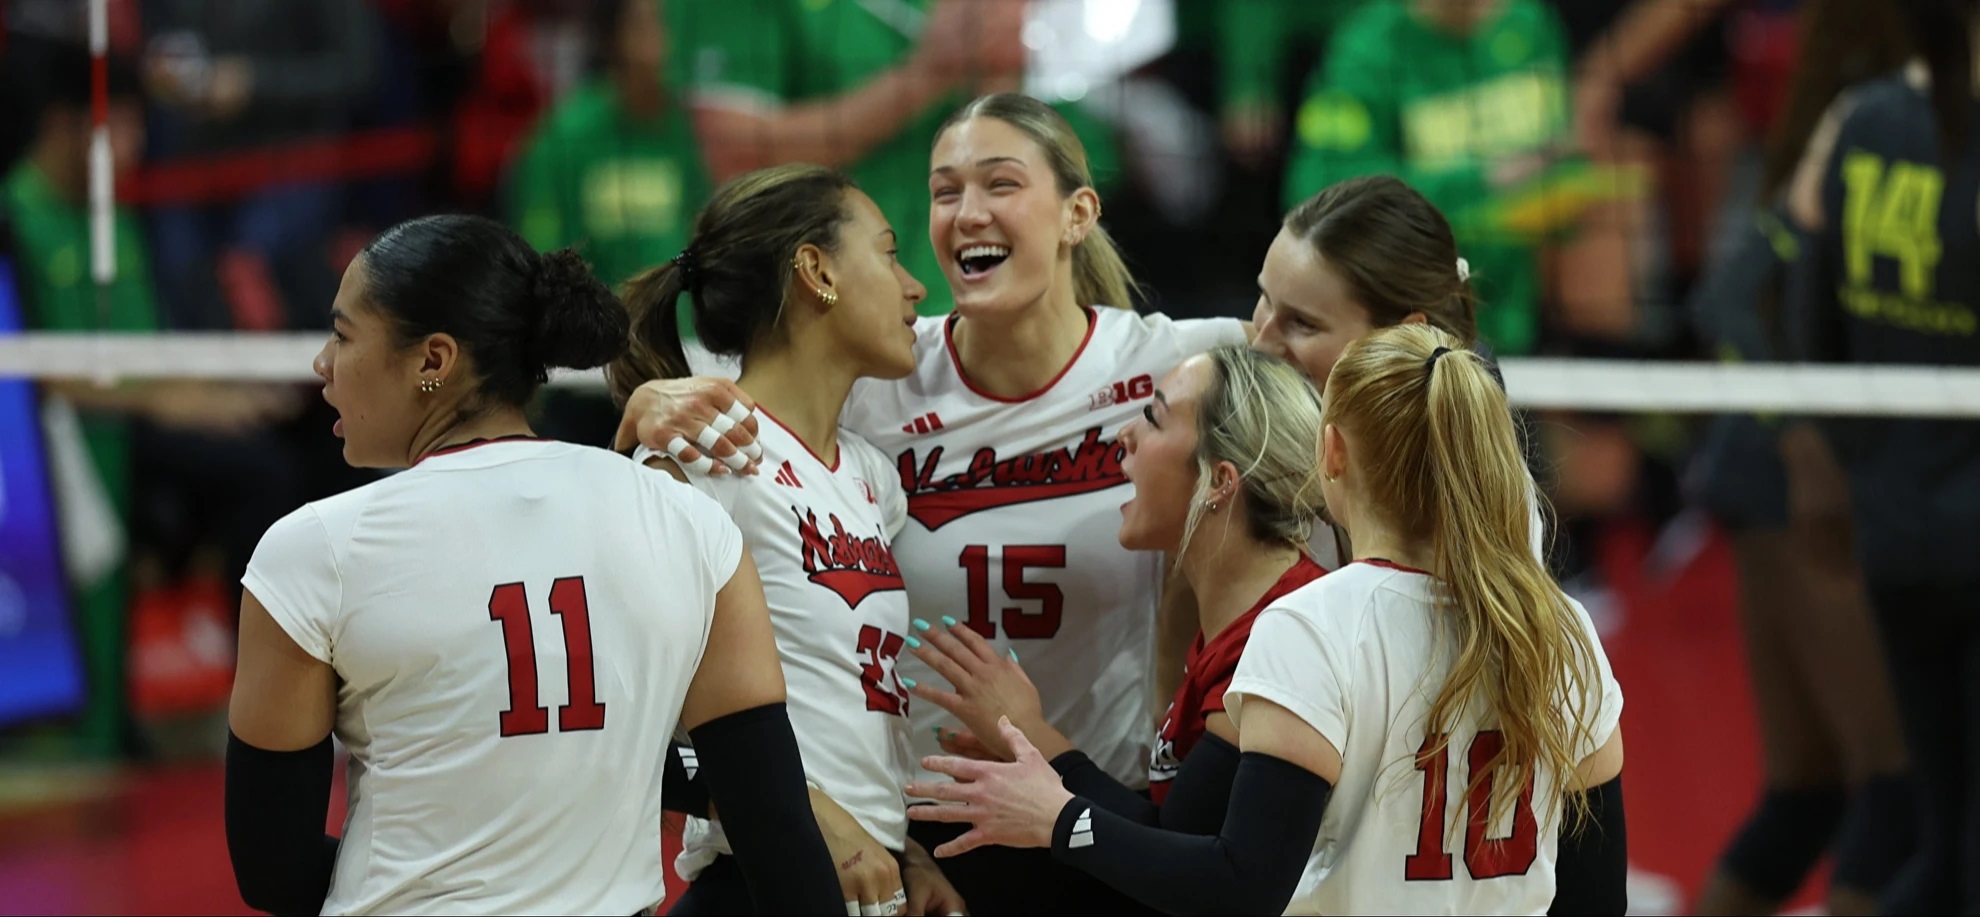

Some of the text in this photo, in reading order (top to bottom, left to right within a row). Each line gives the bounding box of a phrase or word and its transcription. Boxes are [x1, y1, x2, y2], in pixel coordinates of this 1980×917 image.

[1842, 151, 1943, 300] 14
[488, 575, 606, 737] 11
[959, 545, 1066, 640] 15
[1405, 730, 1538, 882] 10
